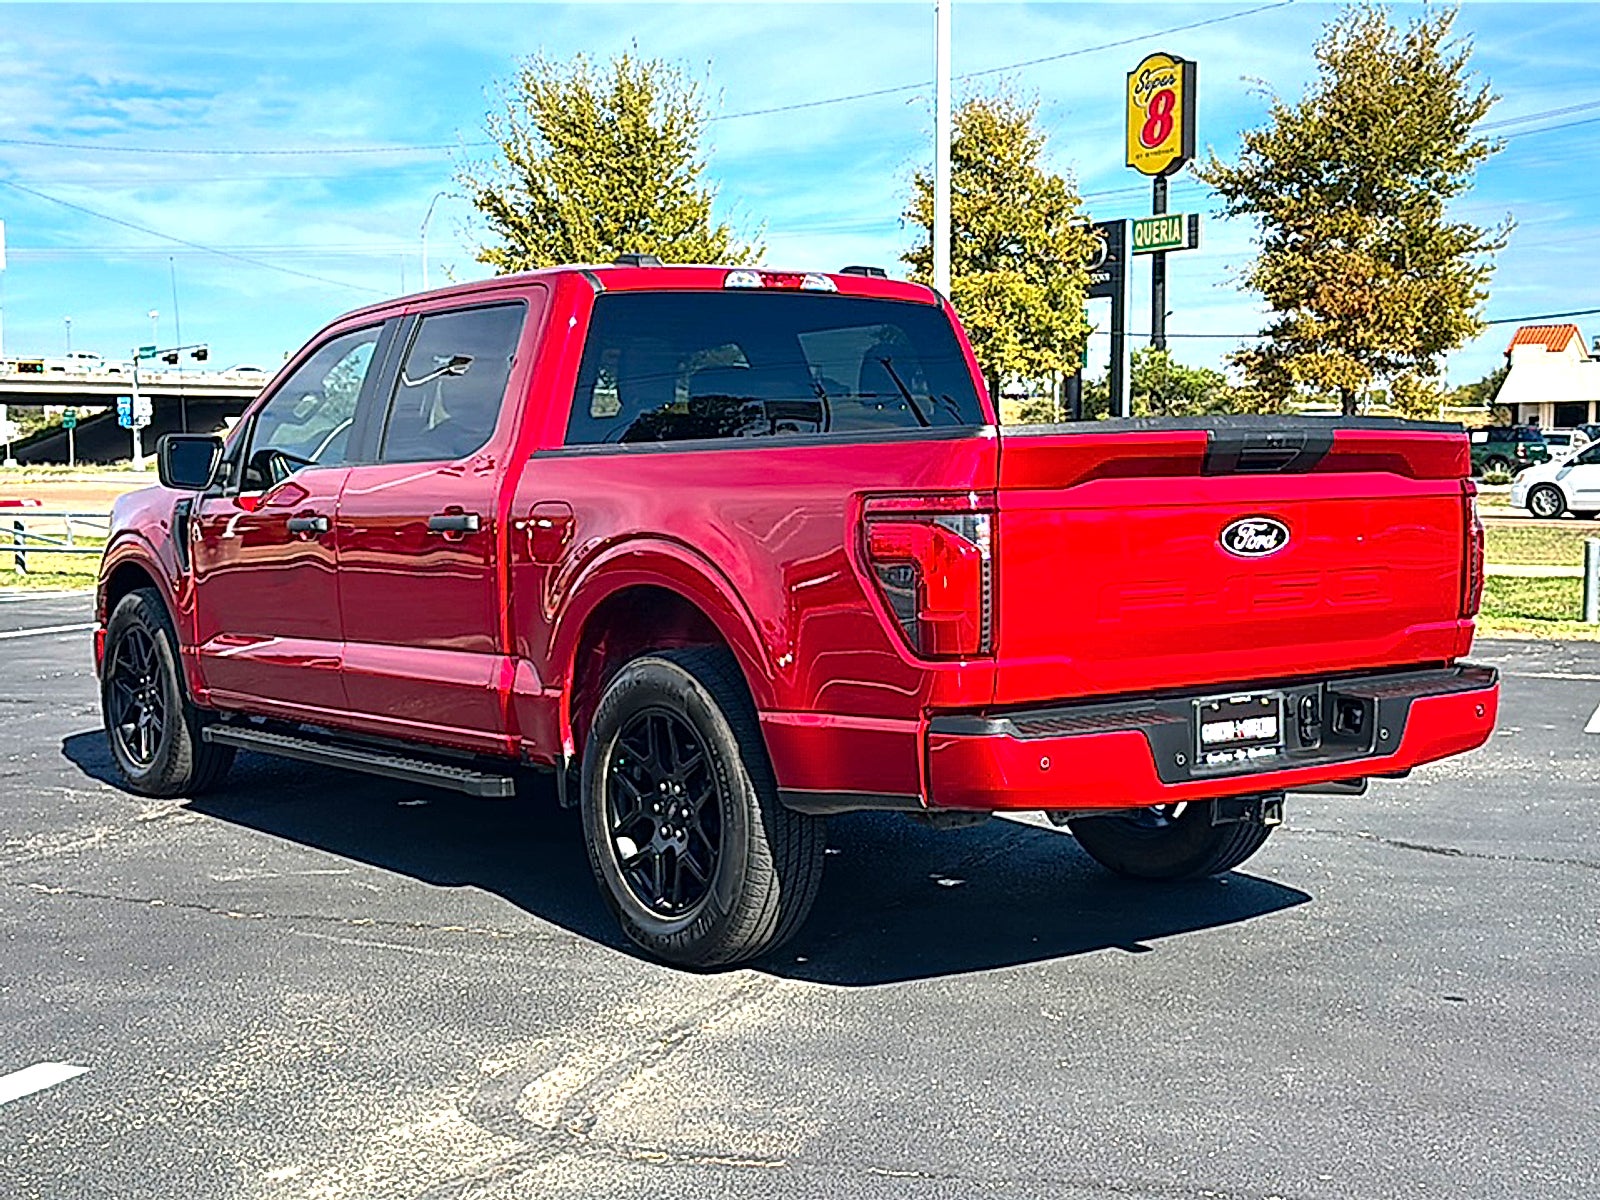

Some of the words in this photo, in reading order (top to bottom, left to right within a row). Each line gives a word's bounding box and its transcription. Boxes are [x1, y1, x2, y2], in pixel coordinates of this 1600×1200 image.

[1135, 68, 1176, 102] Super
[1141, 89, 1176, 148] 8
[1135, 218, 1181, 247] QUERIA
[1233, 523, 1278, 550] Ford
